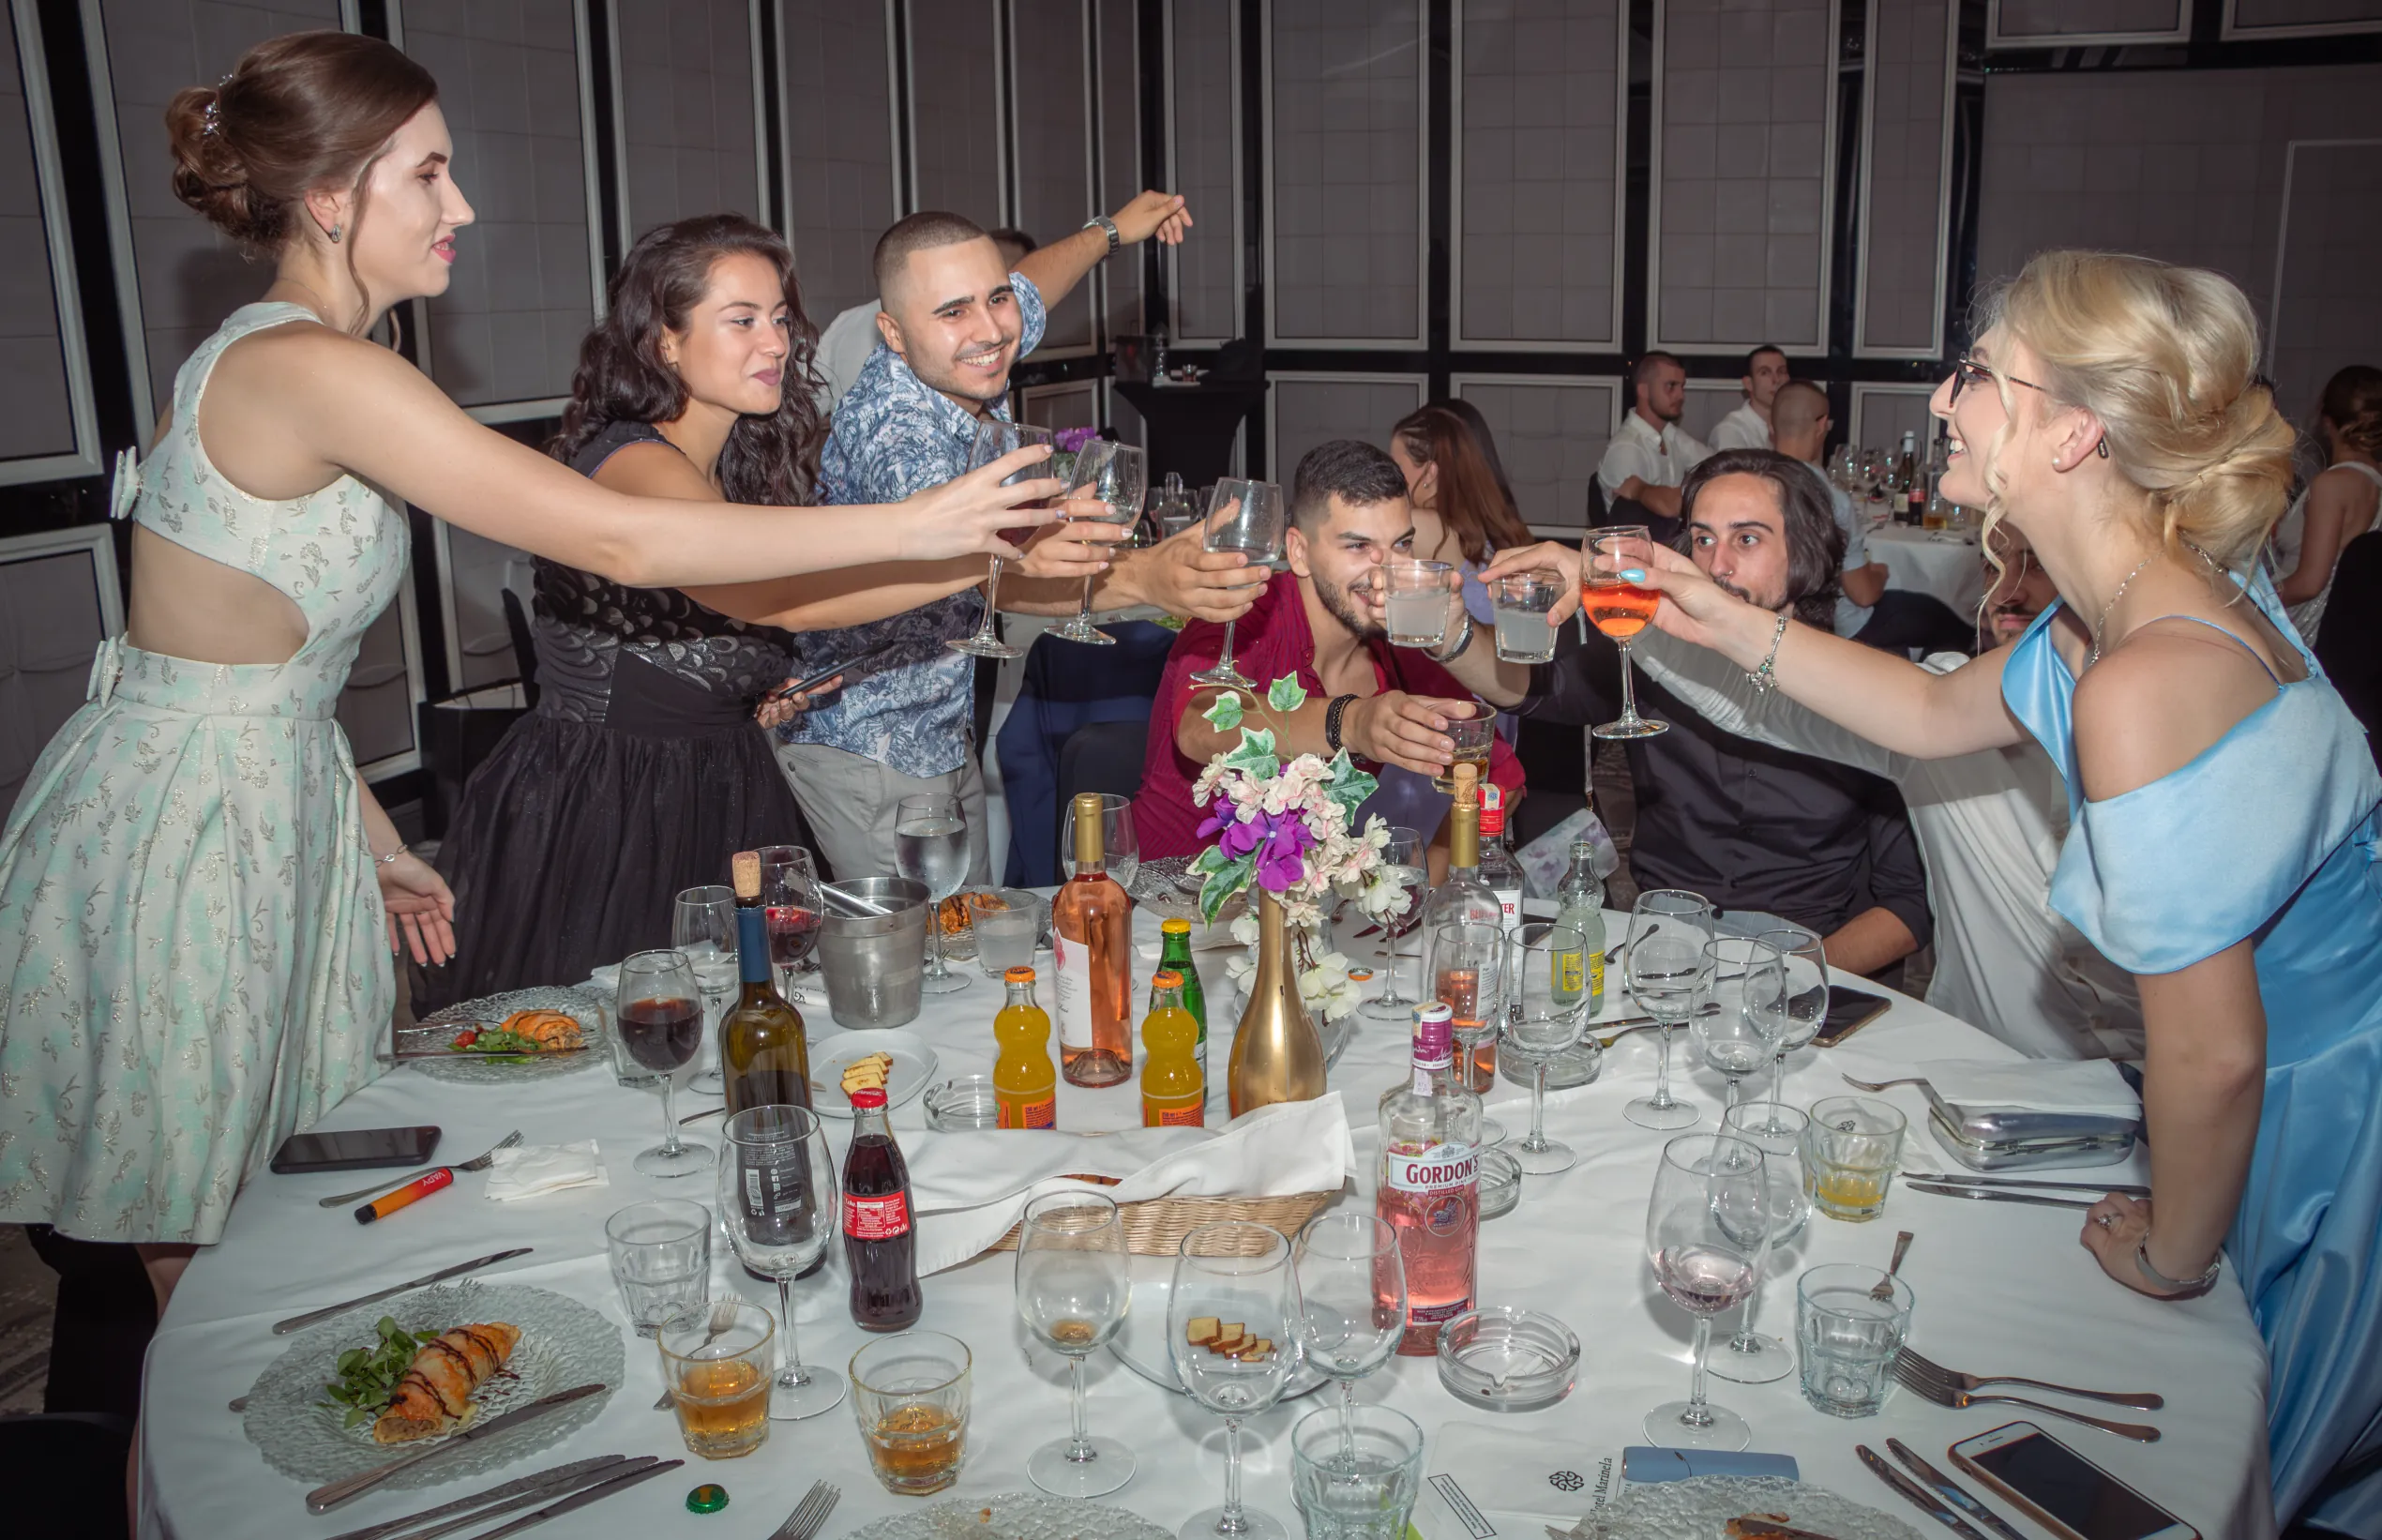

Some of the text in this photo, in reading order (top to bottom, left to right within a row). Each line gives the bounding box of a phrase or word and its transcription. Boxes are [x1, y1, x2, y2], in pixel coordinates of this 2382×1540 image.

[422, 1171, 445, 1186] VAPY
[1406, 1154, 1479, 1184] GORDON'S
[1594, 1457, 1612, 1494] Marinela
